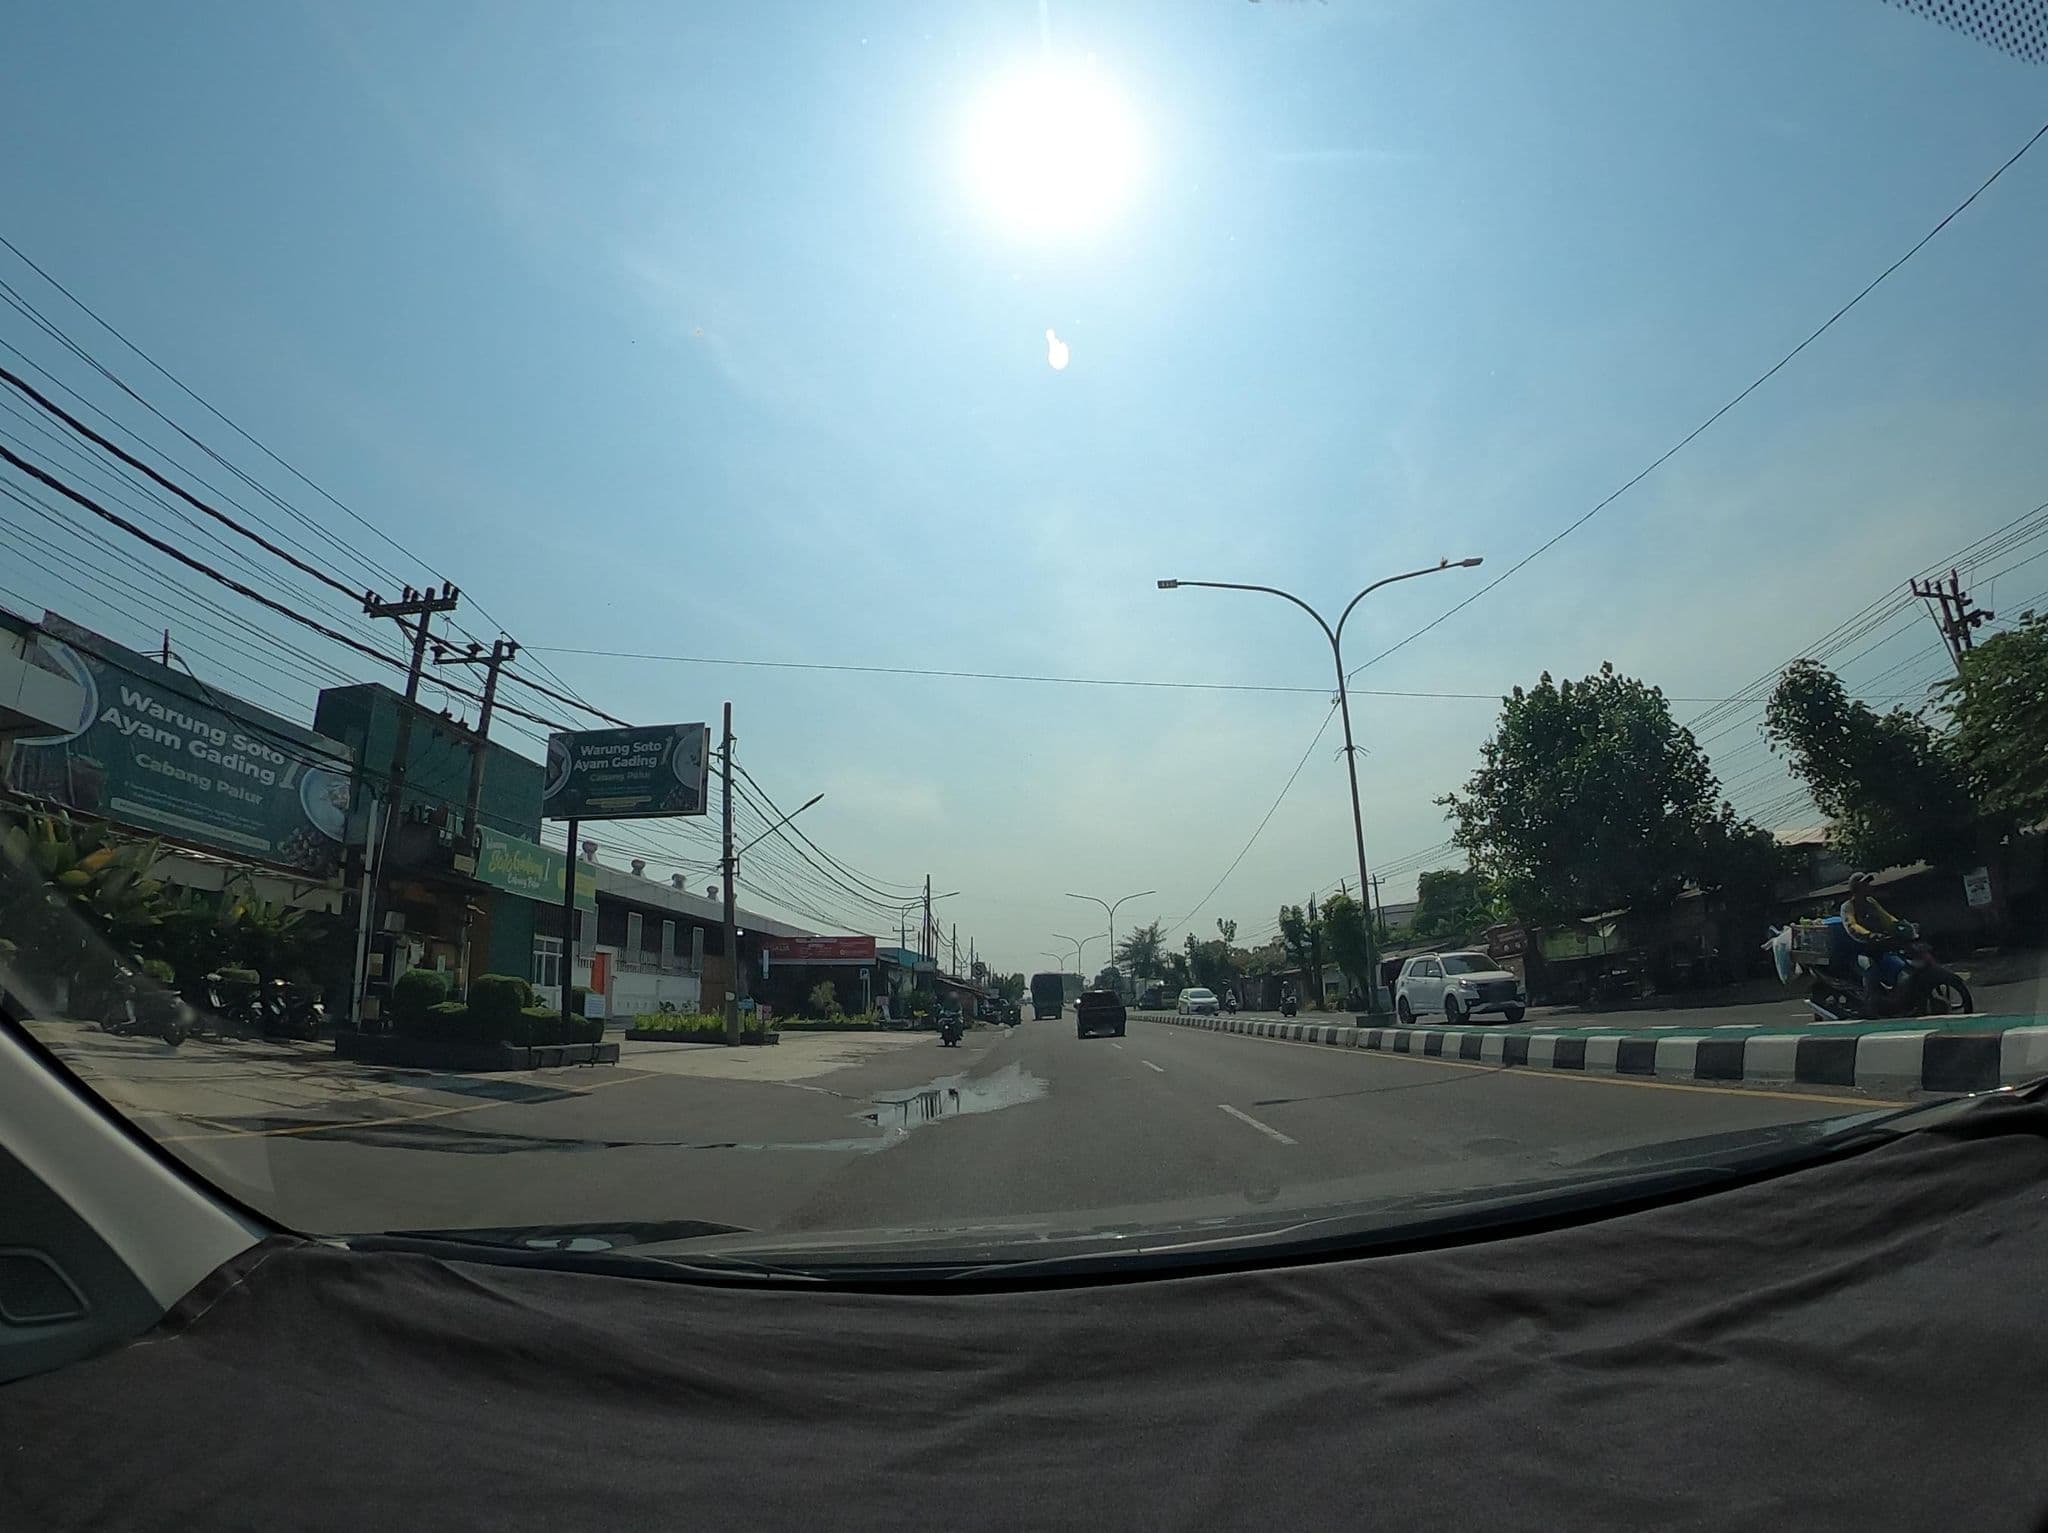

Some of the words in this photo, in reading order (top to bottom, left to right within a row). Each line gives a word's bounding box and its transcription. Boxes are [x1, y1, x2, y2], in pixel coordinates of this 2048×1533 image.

[100, 707, 181, 750] Ayam
[189, 740, 275, 785] Gading
[121, 685, 226, 746] Warung
[232, 733, 285, 765] Soto
[580, 743, 630, 756] Warung
[632, 741, 662, 753] Soto
[136, 753, 212, 791] Cabang
[217, 780, 264, 805] Palur
[574, 757, 609, 772] Ayam
[612, 755, 657, 768] Gading
